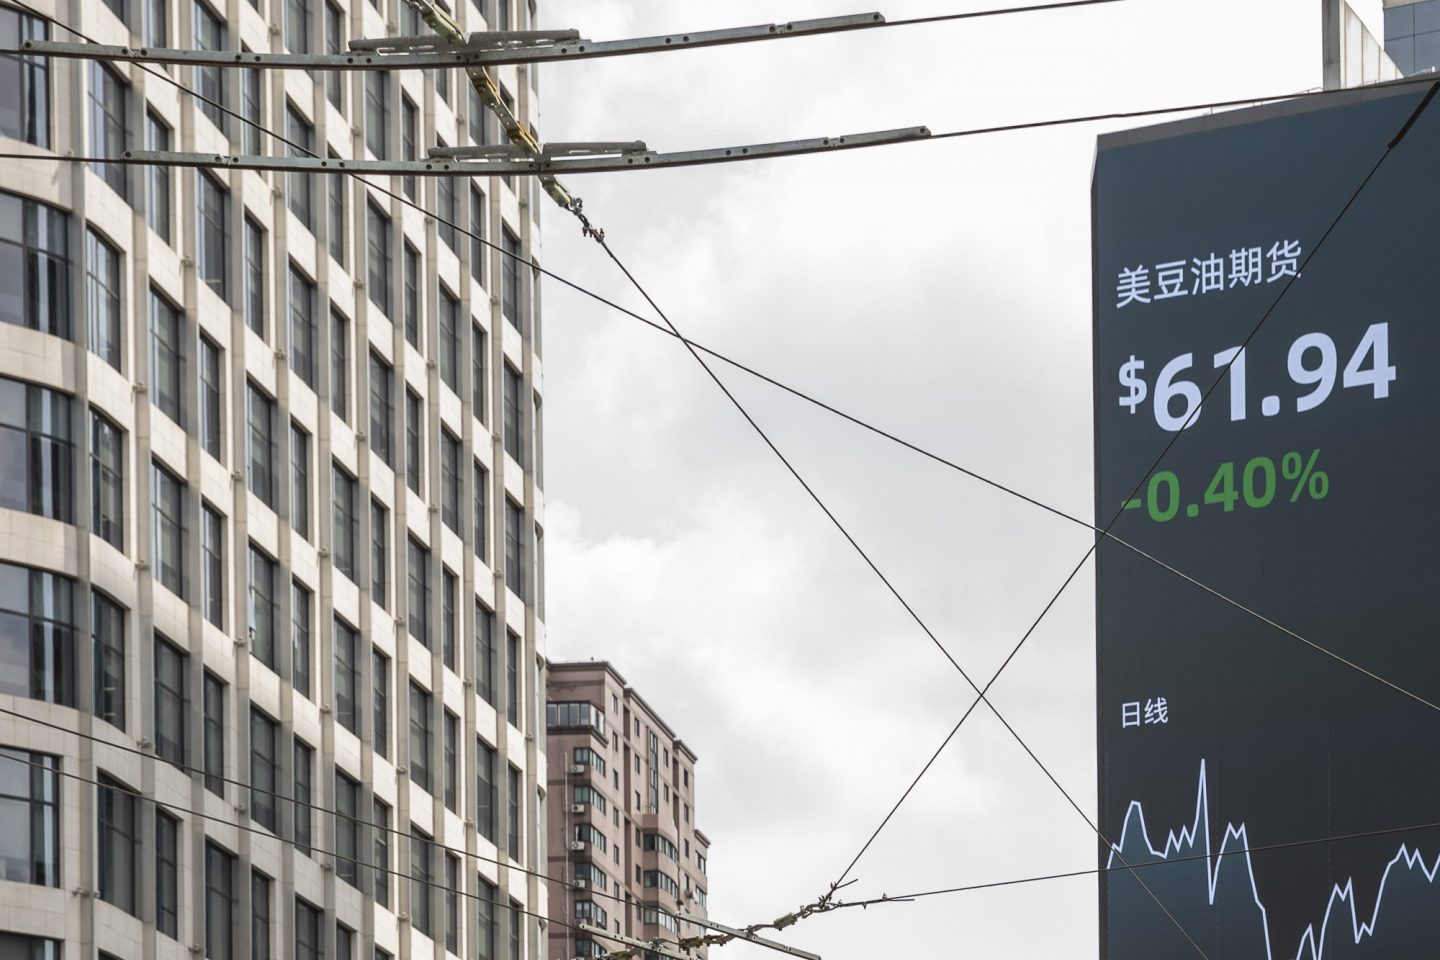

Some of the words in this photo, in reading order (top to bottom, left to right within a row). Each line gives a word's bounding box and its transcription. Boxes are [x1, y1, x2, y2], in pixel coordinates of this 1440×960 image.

[1116, 239, 1302, 308] 美豆油期货
[1118, 322, 1397, 432] $61.94
[1121, 448, 1329, 522] -0.40%
[1121, 696, 1168, 728] 日线
